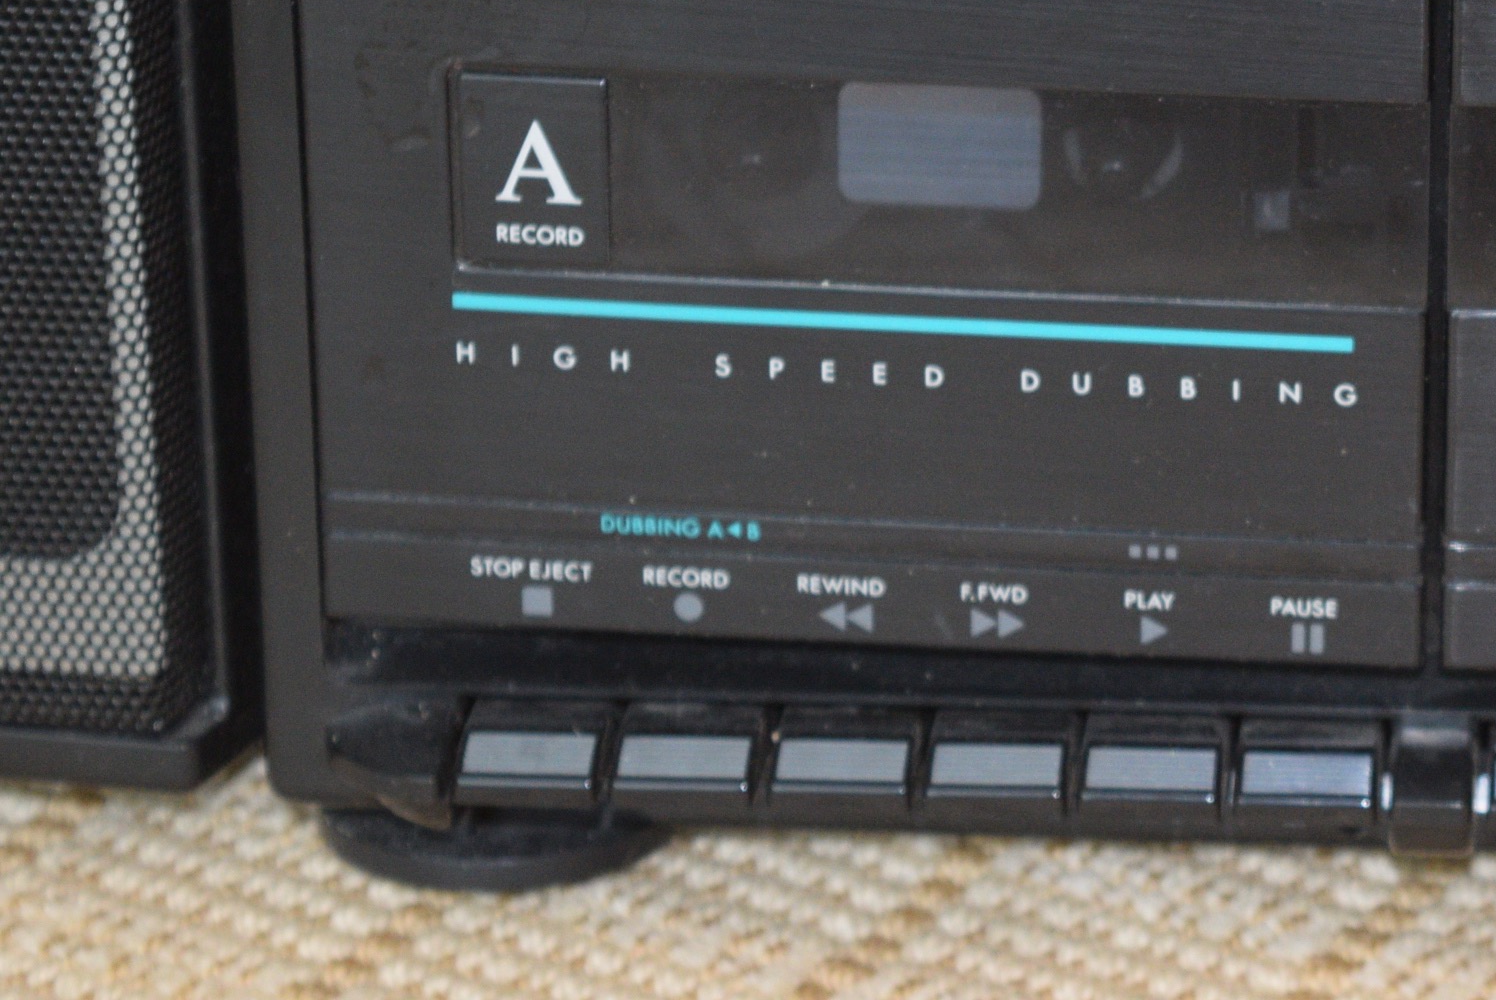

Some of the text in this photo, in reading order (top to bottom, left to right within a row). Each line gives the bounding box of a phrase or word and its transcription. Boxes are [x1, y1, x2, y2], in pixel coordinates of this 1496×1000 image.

[495, 120, 582, 206] A
[495, 223, 585, 247] RECORD
[455, 341, 1358, 407] HIGH SPEED DUBBING
[600, 513, 701, 538] DUBBING
[470, 555, 592, 582] STOP EJECT
[642, 566, 730, 589] RECORD
[796, 573, 886, 598] REWIND
[960, 582, 1028, 604] F.FWD
[1123, 589, 1174, 611] PLAY
[1270, 596, 1337, 619] PAUSE
